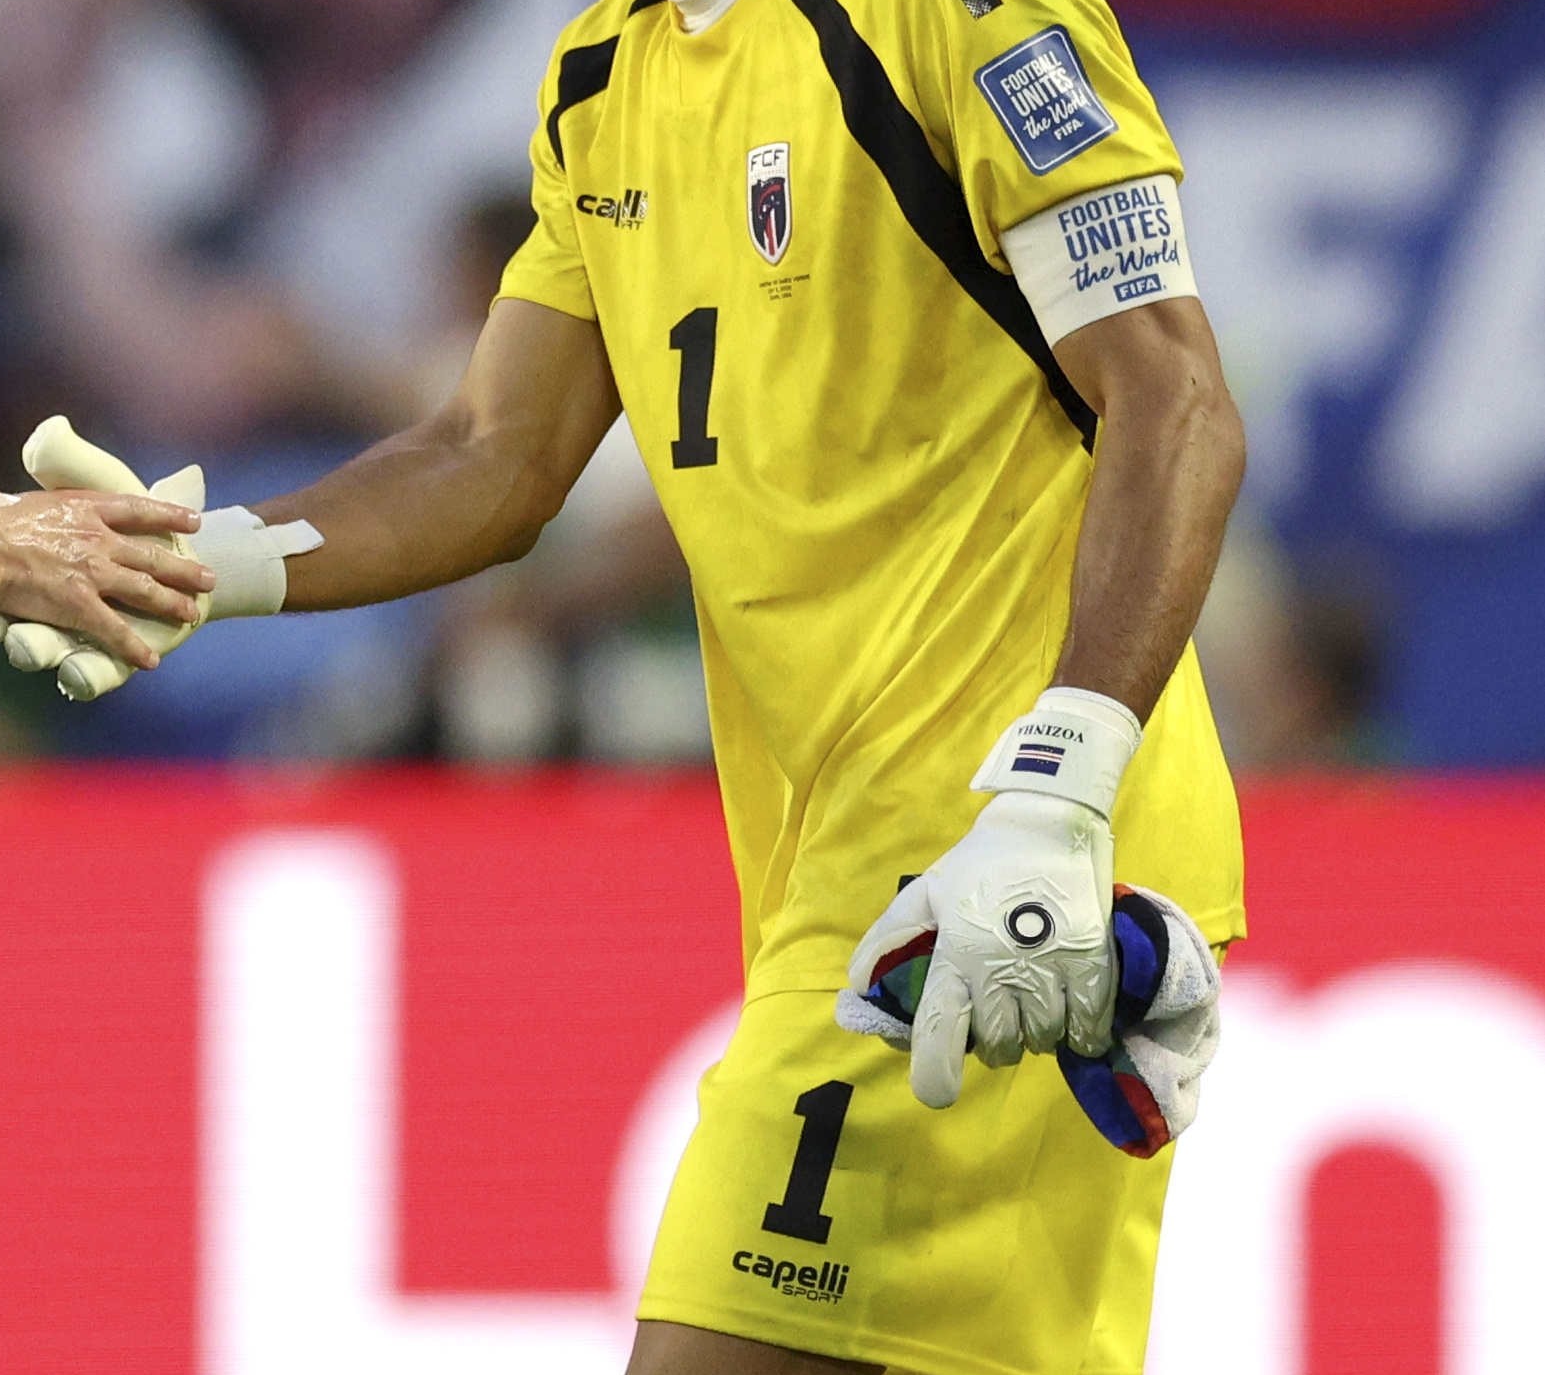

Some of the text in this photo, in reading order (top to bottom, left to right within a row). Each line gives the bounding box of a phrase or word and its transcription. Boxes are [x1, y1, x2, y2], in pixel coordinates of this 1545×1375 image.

[1000, 50, 1062, 96] FOOTBALL
[1010, 67, 1074, 117] UNITES
[1023, 88, 1092, 140] the World
[1054, 119, 1083, 141] FIFA
[751, 149, 785, 172] FCF
[1058, 185, 1165, 233] FOOTBALL
[1065, 208, 1171, 262] UNITES
[1069, 239, 1181, 292] the World
[1116, 277, 1160, 299] FIFA
[668, 307, 719, 469] 1
[1018, 724, 1084, 744] VOZINHA
[761, 1080, 854, 1245] 1
[732, 1250, 850, 1296] capelli
[781, 1284, 843, 1305] SPORT
